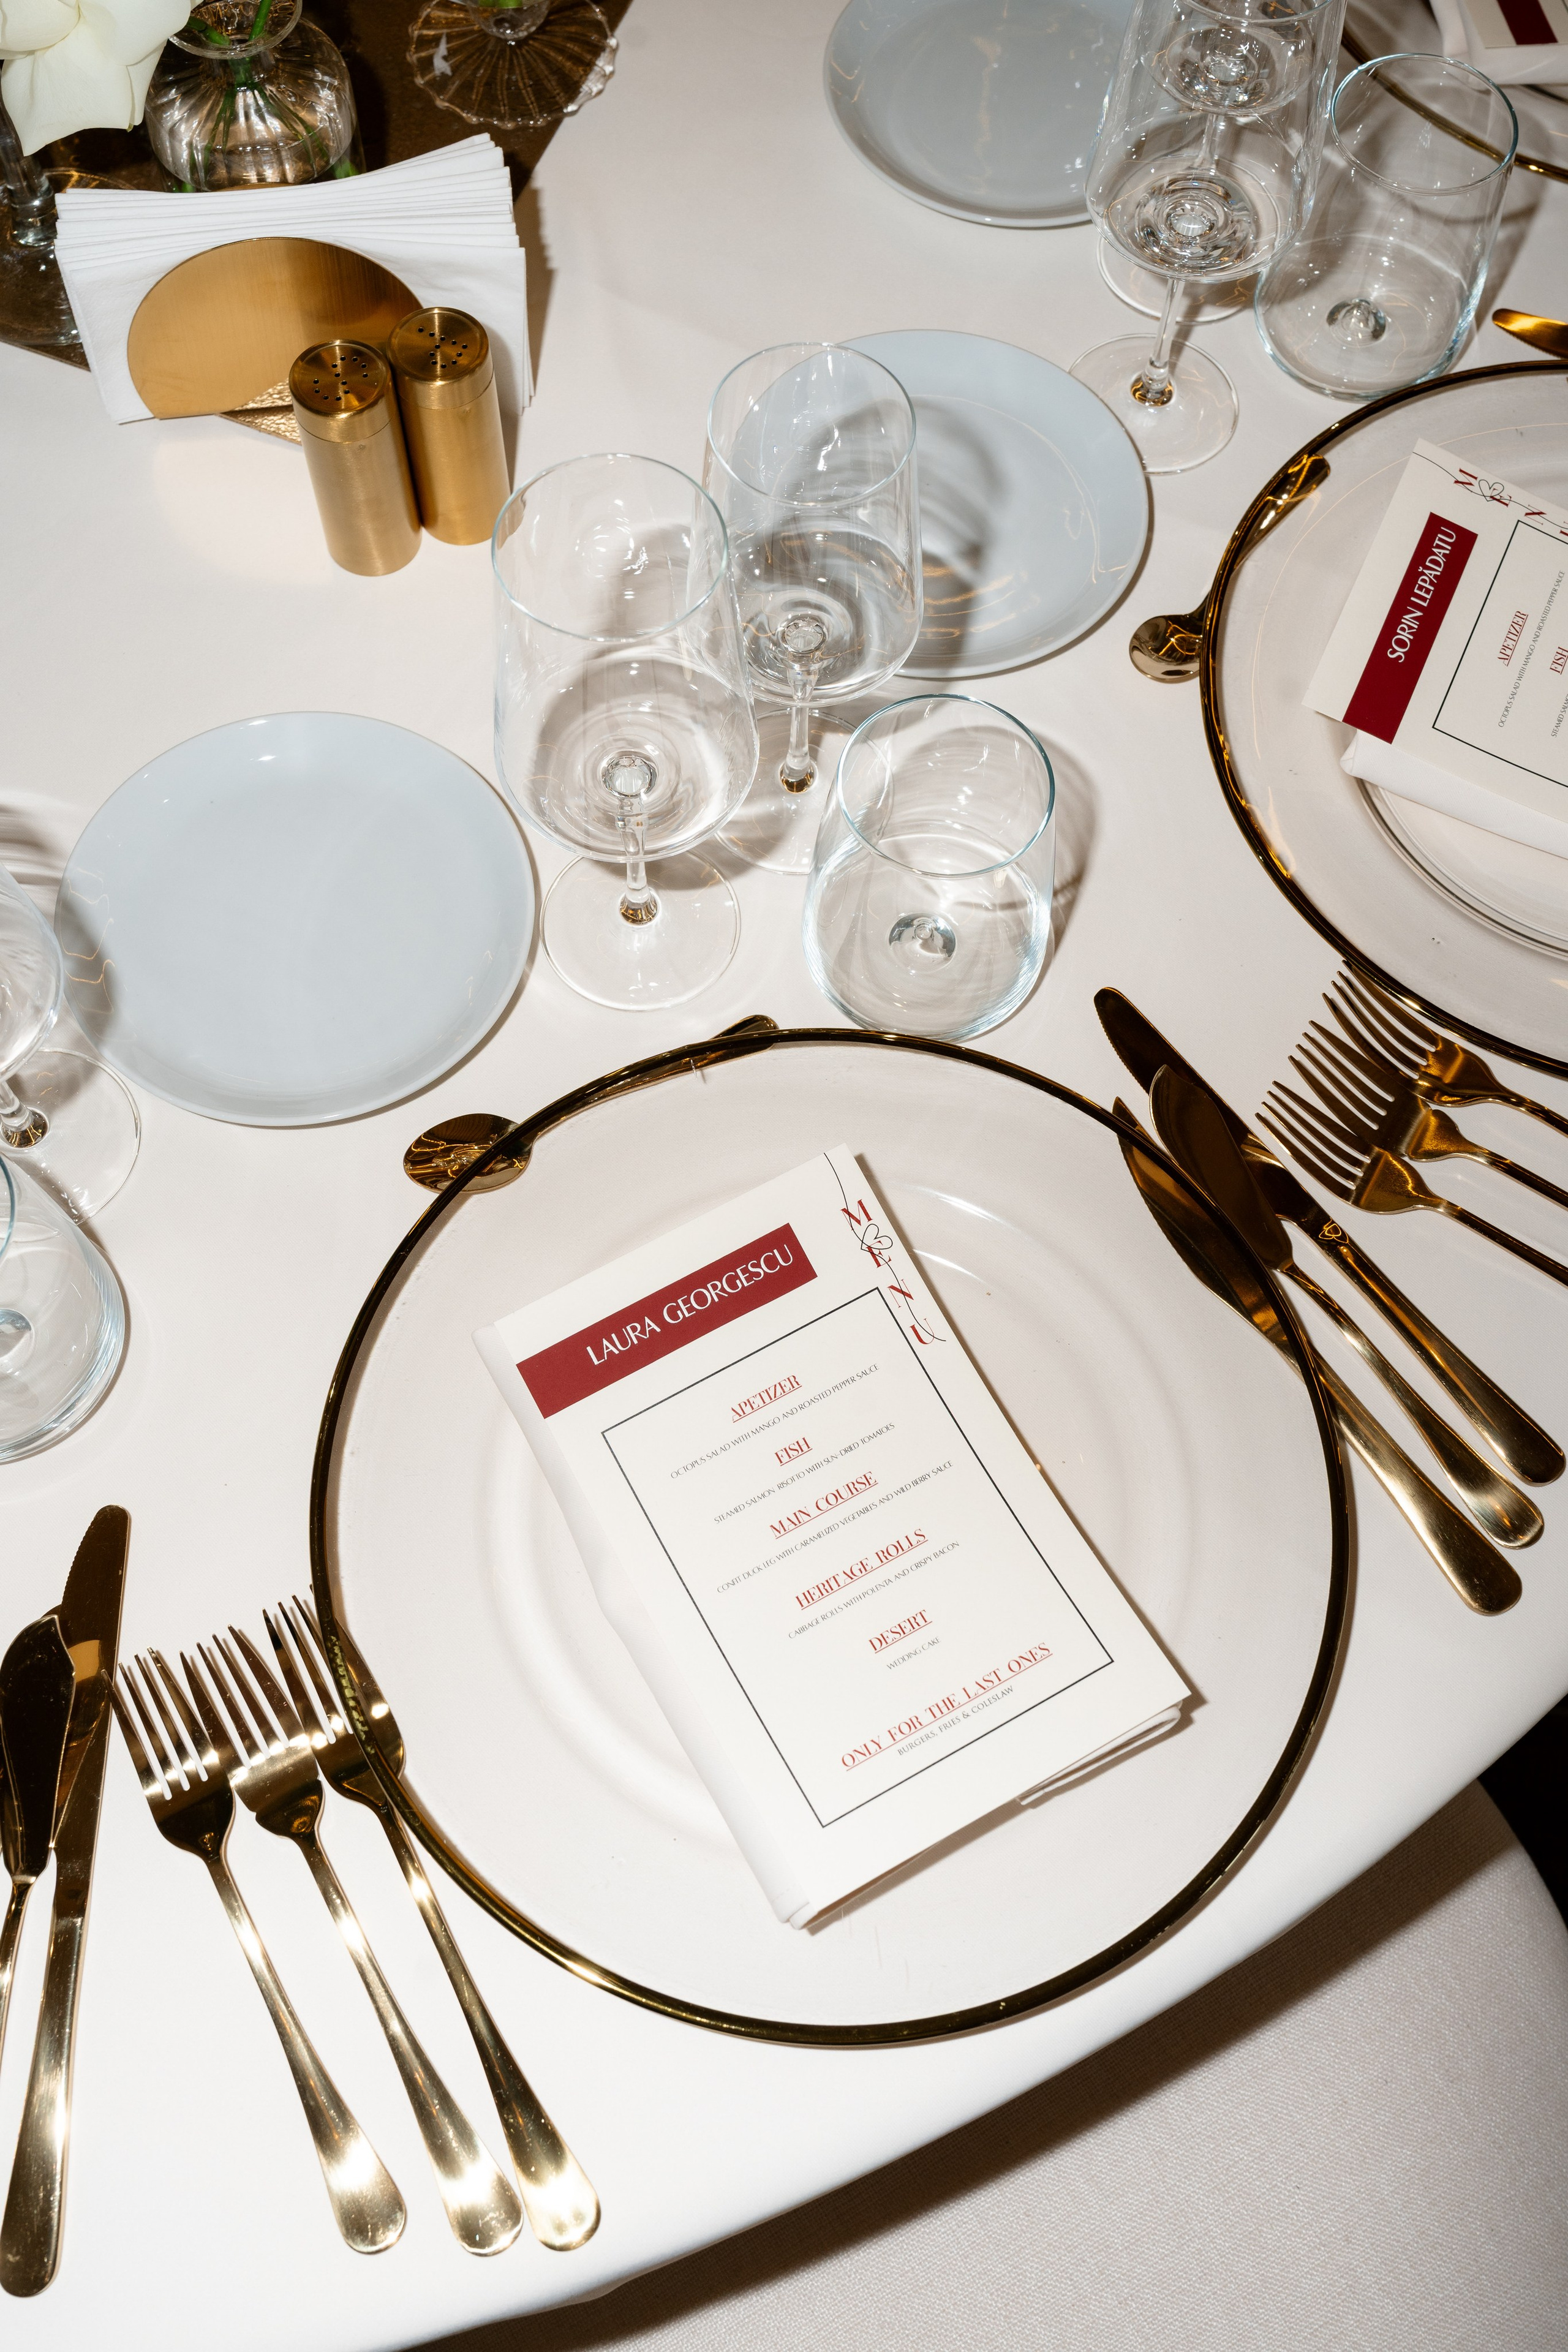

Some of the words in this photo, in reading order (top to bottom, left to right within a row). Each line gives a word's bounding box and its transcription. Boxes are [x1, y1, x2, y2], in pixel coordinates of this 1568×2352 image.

[1387, 607, 1423, 662] SORIN
[1411, 527, 1455, 606] LEPĂDATU
[1498, 611, 1526, 665] APETIZER
[1498, 701, 1513, 727] OCTOPUS
[1509, 682, 1520, 701] SALAD
[1517, 666, 1526, 680] WITH
[1523, 644, 1535, 667] MANGO
[1532, 631, 1540, 644] AND
[1537, 606, 1550, 631] ROASTED
[1547, 587, 1558, 606] PEPPER
[1554, 571, 1565, 587] SAUCE
[1550, 646, 1568, 673] FISH
[1551, 714, 1564, 737] STEAMED
[587, 1316, 661, 1365] LAURA
[663, 1245, 793, 1323] GEORGESCU
[840, 1199, 934, 1344] MENU
[671, 1457, 706, 1479] OCTOPUS
[706, 1444, 730, 1459] SALAD
[731, 1433, 750, 1446] WITH
[751, 1417, 780, 1436] MANGO
[782, 1407, 798, 1420] AND
[798, 1390, 831, 1411] ROASTED
[832, 1376, 856, 1392] PEPPER
[856, 1363, 879, 1379] SAUCE
[731, 1376, 800, 1420] APETIZER
[714, 1504, 745, 1523] STEAMED
[745, 1488, 775, 1507] SALMON
[777, 1471, 805, 1490] RISOTTO
[805, 1461, 823, 1473] WITH
[824, 1442, 859, 1464] SUN-DRIED
[861, 1423, 894, 1444] TOMATOES
[775, 1438, 810, 1464] FISH
[717, 1576, 742, 1593] CONFIT
[742, 1566, 763, 1579] DUCK
[763, 1559, 776, 1568] LEG
[776, 1548, 794, 1560] WITH
[795, 1523, 839, 1550] CARAMELIZED
[840, 1502, 877, 1525] VEGETABLES
[879, 1494, 893, 1505] AND
[894, 1483, 911, 1496] WILD
[911, 1472, 930, 1487] BERRY
[932, 1460, 953, 1476] SAUCE
[770, 1507, 812, 1538] MAIN
[816, 1471, 877, 1515] COURSE
[788, 1618, 820, 1639] CABBAGE
[821, 1606, 843, 1621] ROLLS
[843, 1594, 862, 1607] WITH
[862, 1579, 893, 1598] POLENTA
[894, 1568, 910, 1581] AND
[910, 1556, 932, 1571] CRISPY
[933, 1541, 959, 1558] BACON
[796, 1558, 873, 1607] HERITAGE
[875, 1529, 925, 1563] ROLLS
[869, 1609, 928, 1651] DESERT
[887, 1649, 921, 1669] WEDDING
[921, 1636, 940, 1651] CAKE
[842, 1736, 882, 1766] ONLY
[888, 1716, 922, 1741] FOR
[925, 1694, 960, 1718] THE
[963, 1668, 1001, 1699] LAST
[1008, 1642, 1050, 1673] ONES
[897, 1730, 937, 1755] BURGERS,
[938, 1716, 960, 1732] FRIES
[971, 1686, 1012, 1713] COLESLAW
